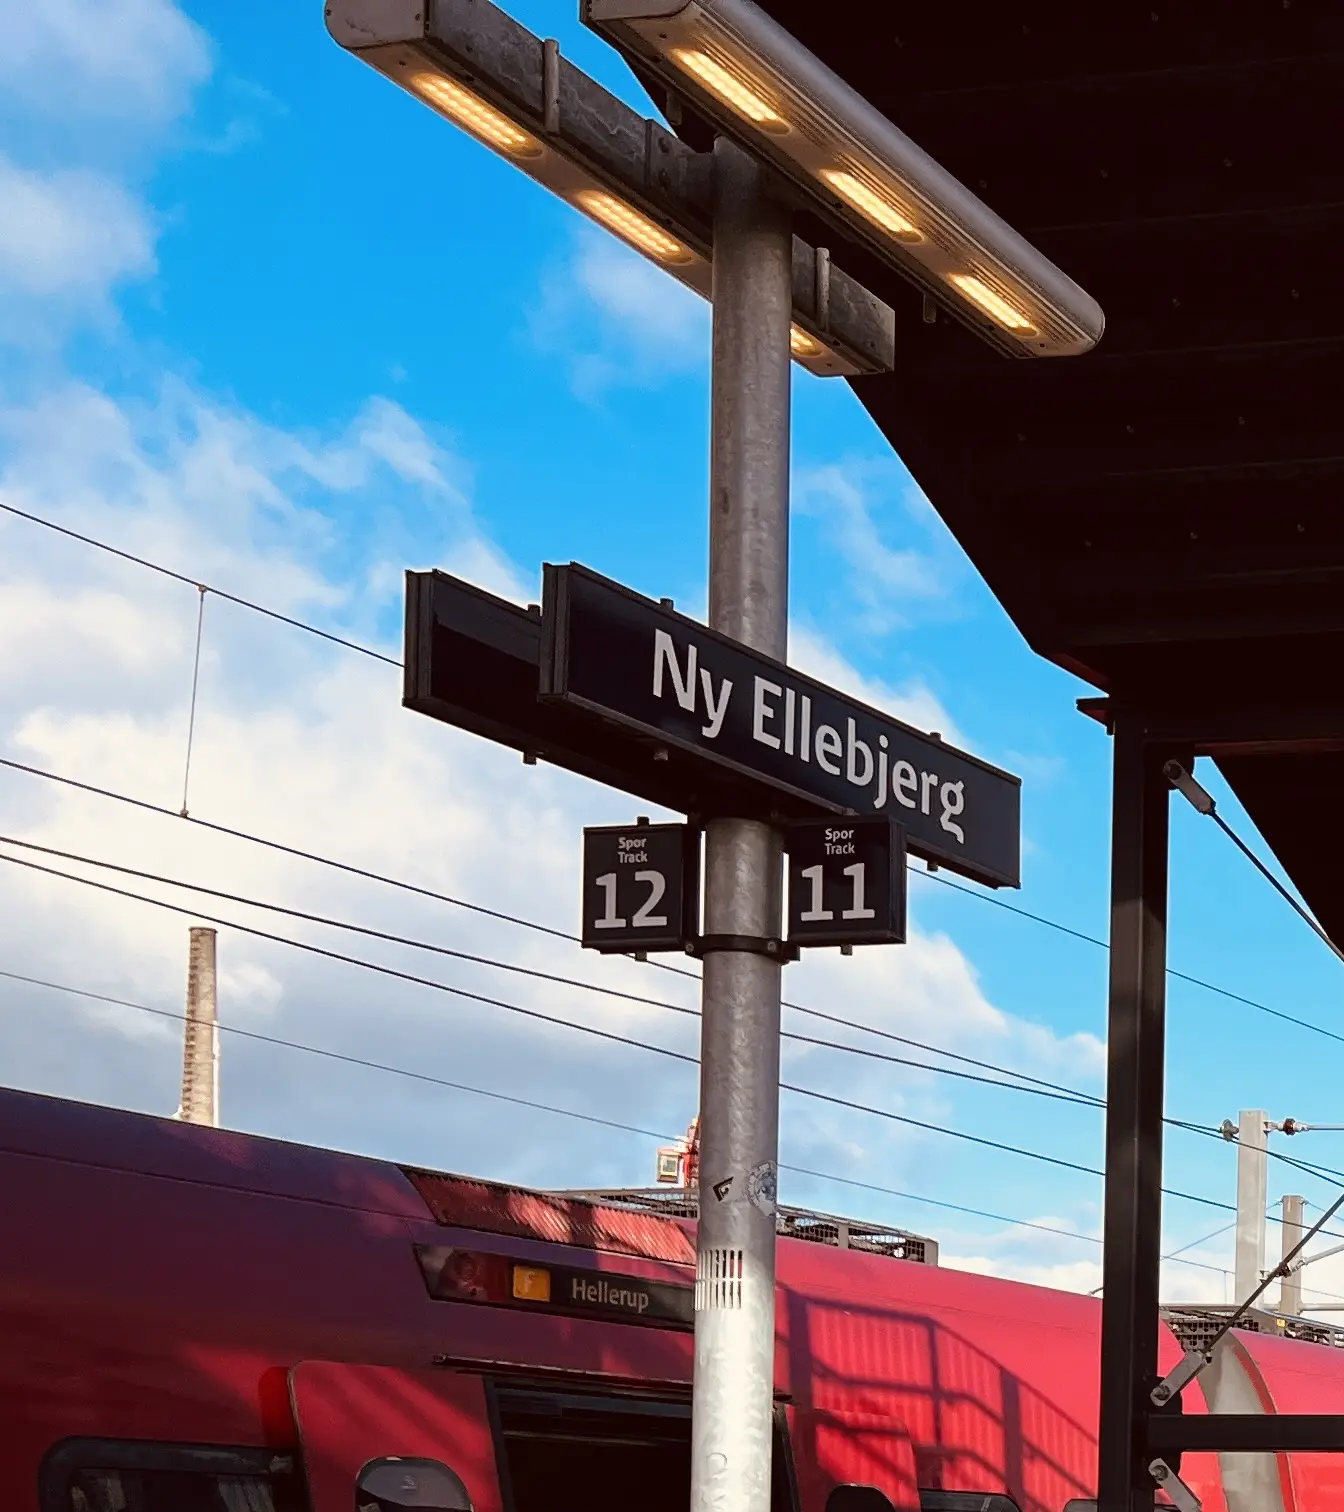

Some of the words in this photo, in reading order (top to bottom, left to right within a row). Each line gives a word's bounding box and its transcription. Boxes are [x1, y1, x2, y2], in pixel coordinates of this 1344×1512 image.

[652, 628, 733, 739] Ny
[752, 675, 965, 844] Ellebjerg
[618, 836, 648, 850] Spor
[826, 828, 855, 842] Spor
[617, 850, 648, 864] Track
[825, 842, 856, 855] Track
[594, 870, 668, 929] 12
[800, 862, 875, 922] 11
[572, 1278, 649, 1313] Hellerup
